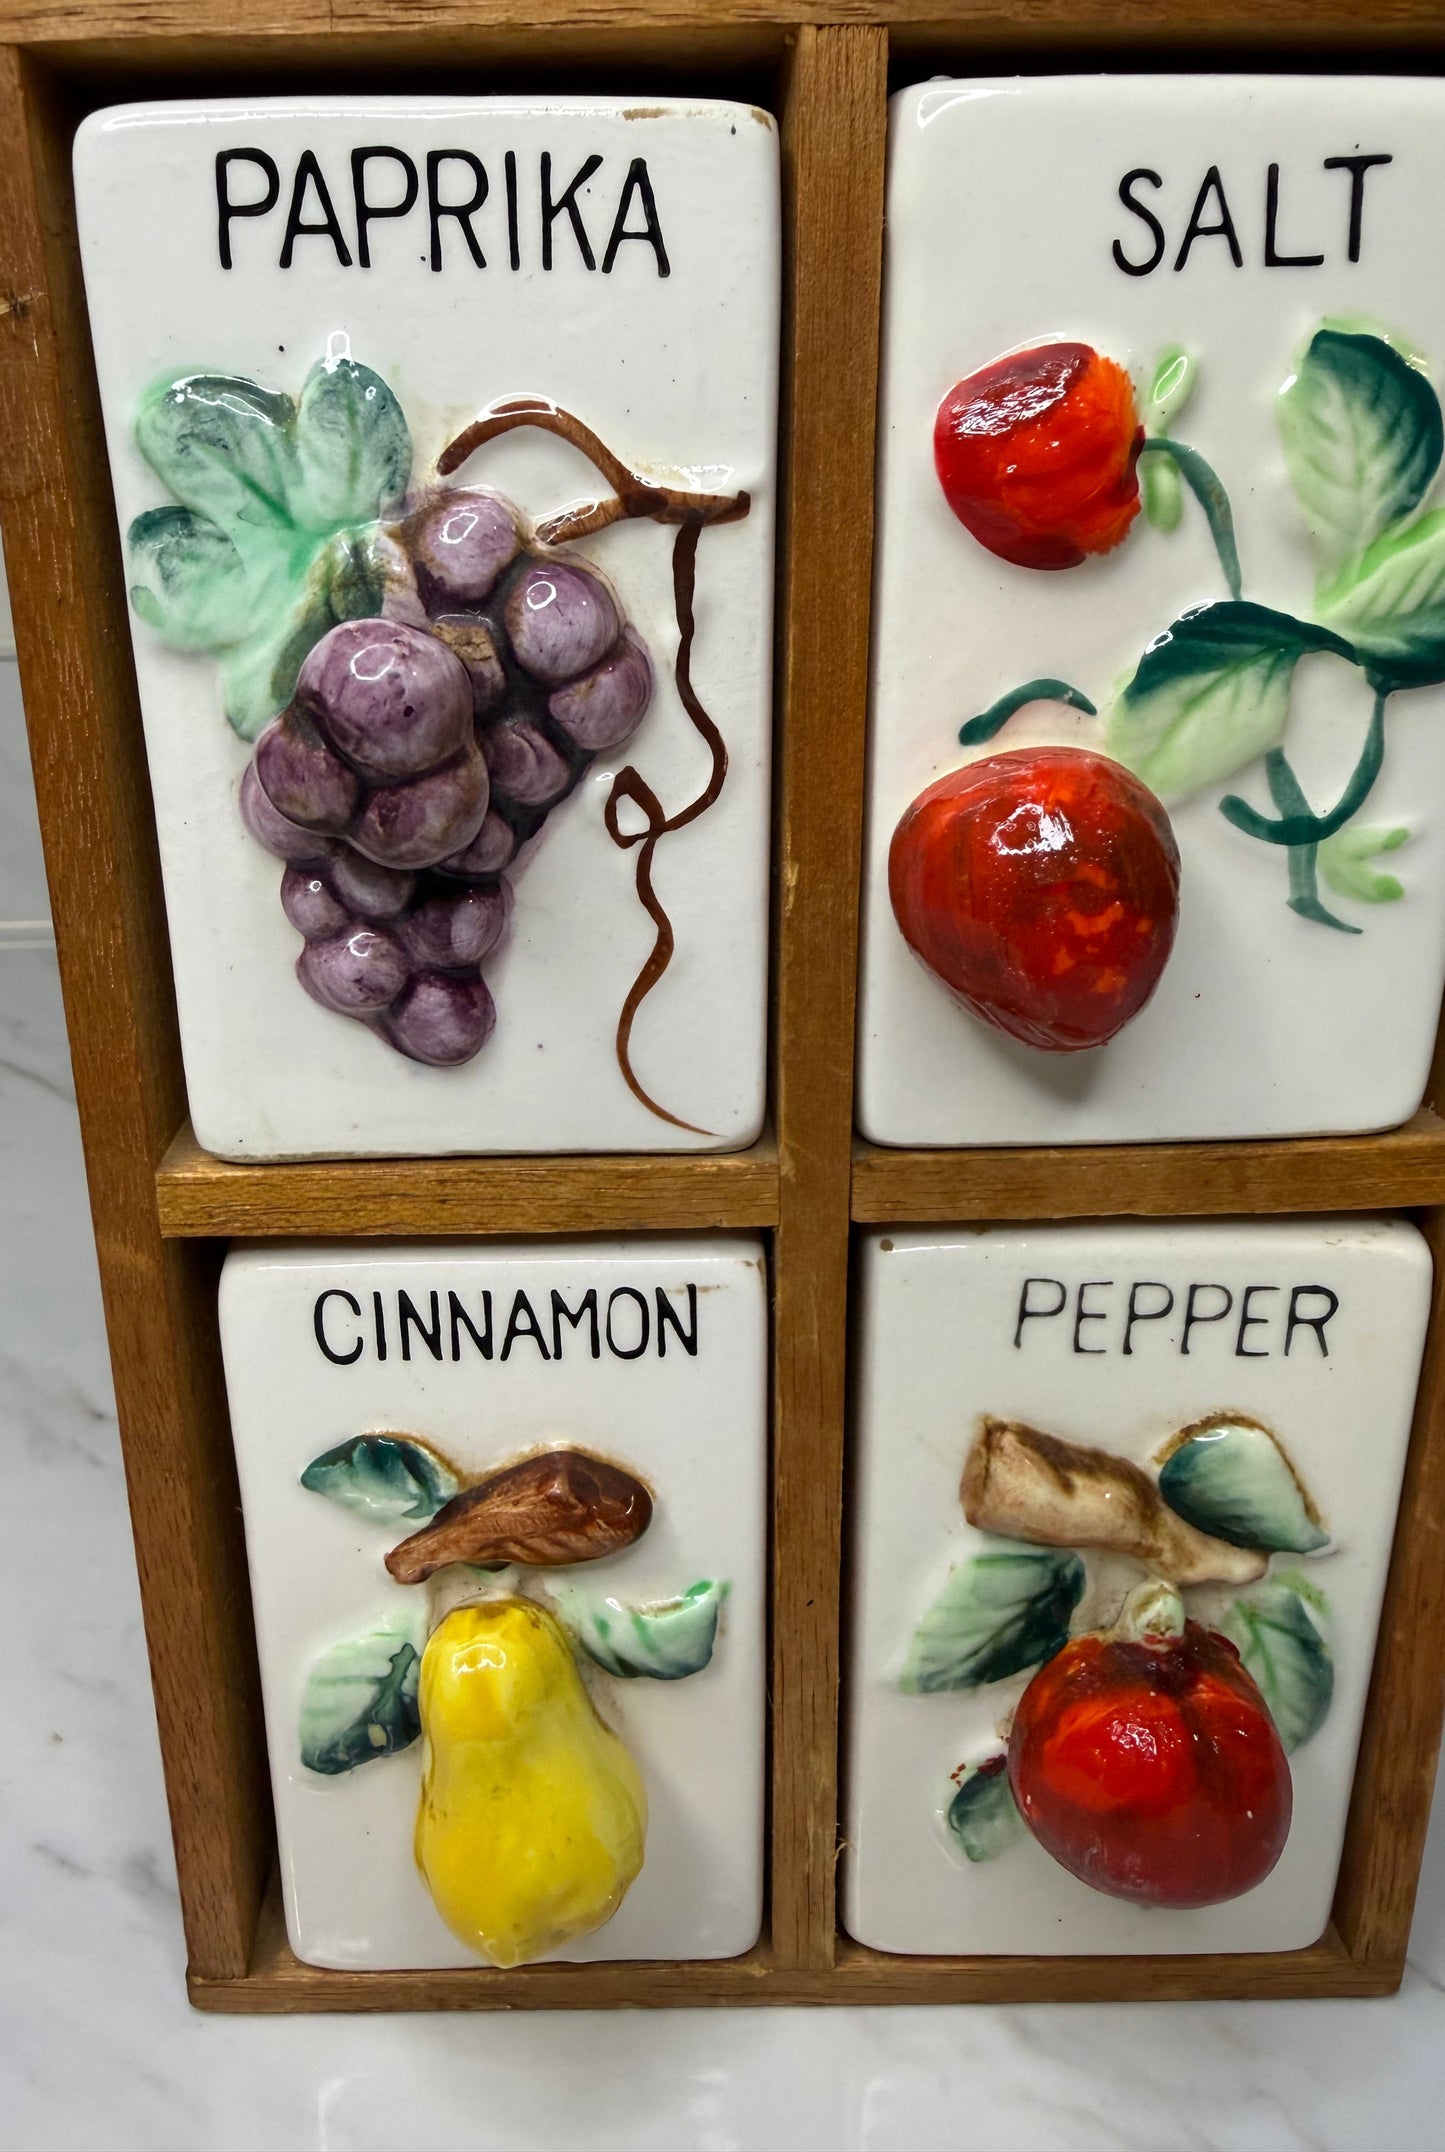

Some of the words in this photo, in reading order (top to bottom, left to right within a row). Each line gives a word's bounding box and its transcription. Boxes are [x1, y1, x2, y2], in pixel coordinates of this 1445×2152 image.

[215, 145, 671, 279] PAPRIKA
[1111, 153, 1394, 277] SALT
[313, 1283, 699, 1366] CINNAMON
[1013, 1278, 1340, 1358] PEPPER
